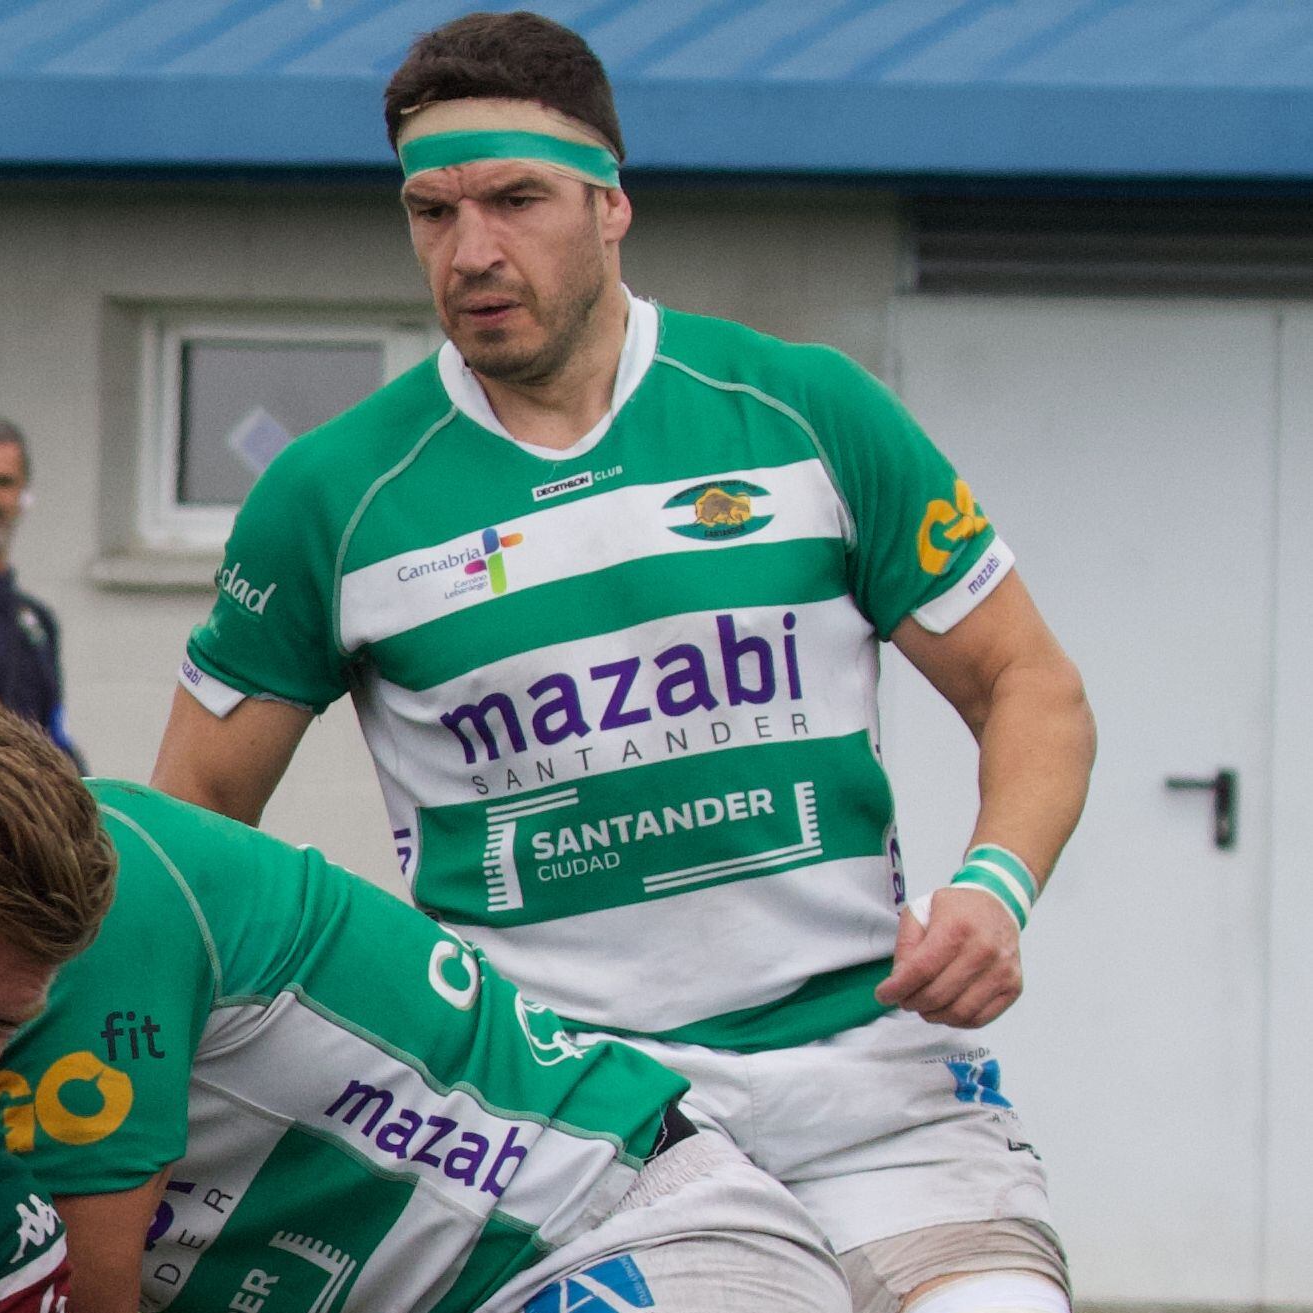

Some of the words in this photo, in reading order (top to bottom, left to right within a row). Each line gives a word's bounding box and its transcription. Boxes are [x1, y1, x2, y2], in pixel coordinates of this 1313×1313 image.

[594, 464, 624, 481] CLUB
[220, 562, 278, 616] dad
[397, 547, 482, 582] Cantabria
[967, 552, 1003, 595] mazabi
[440, 611, 805, 766] mazabi
[472, 713, 810, 796] SANTANDER
[532, 787, 777, 862] SANTANDER
[537, 851, 622, 884] CIUDAD
[100, 1010, 166, 1062] fit
[324, 1079, 529, 1198] mazab
